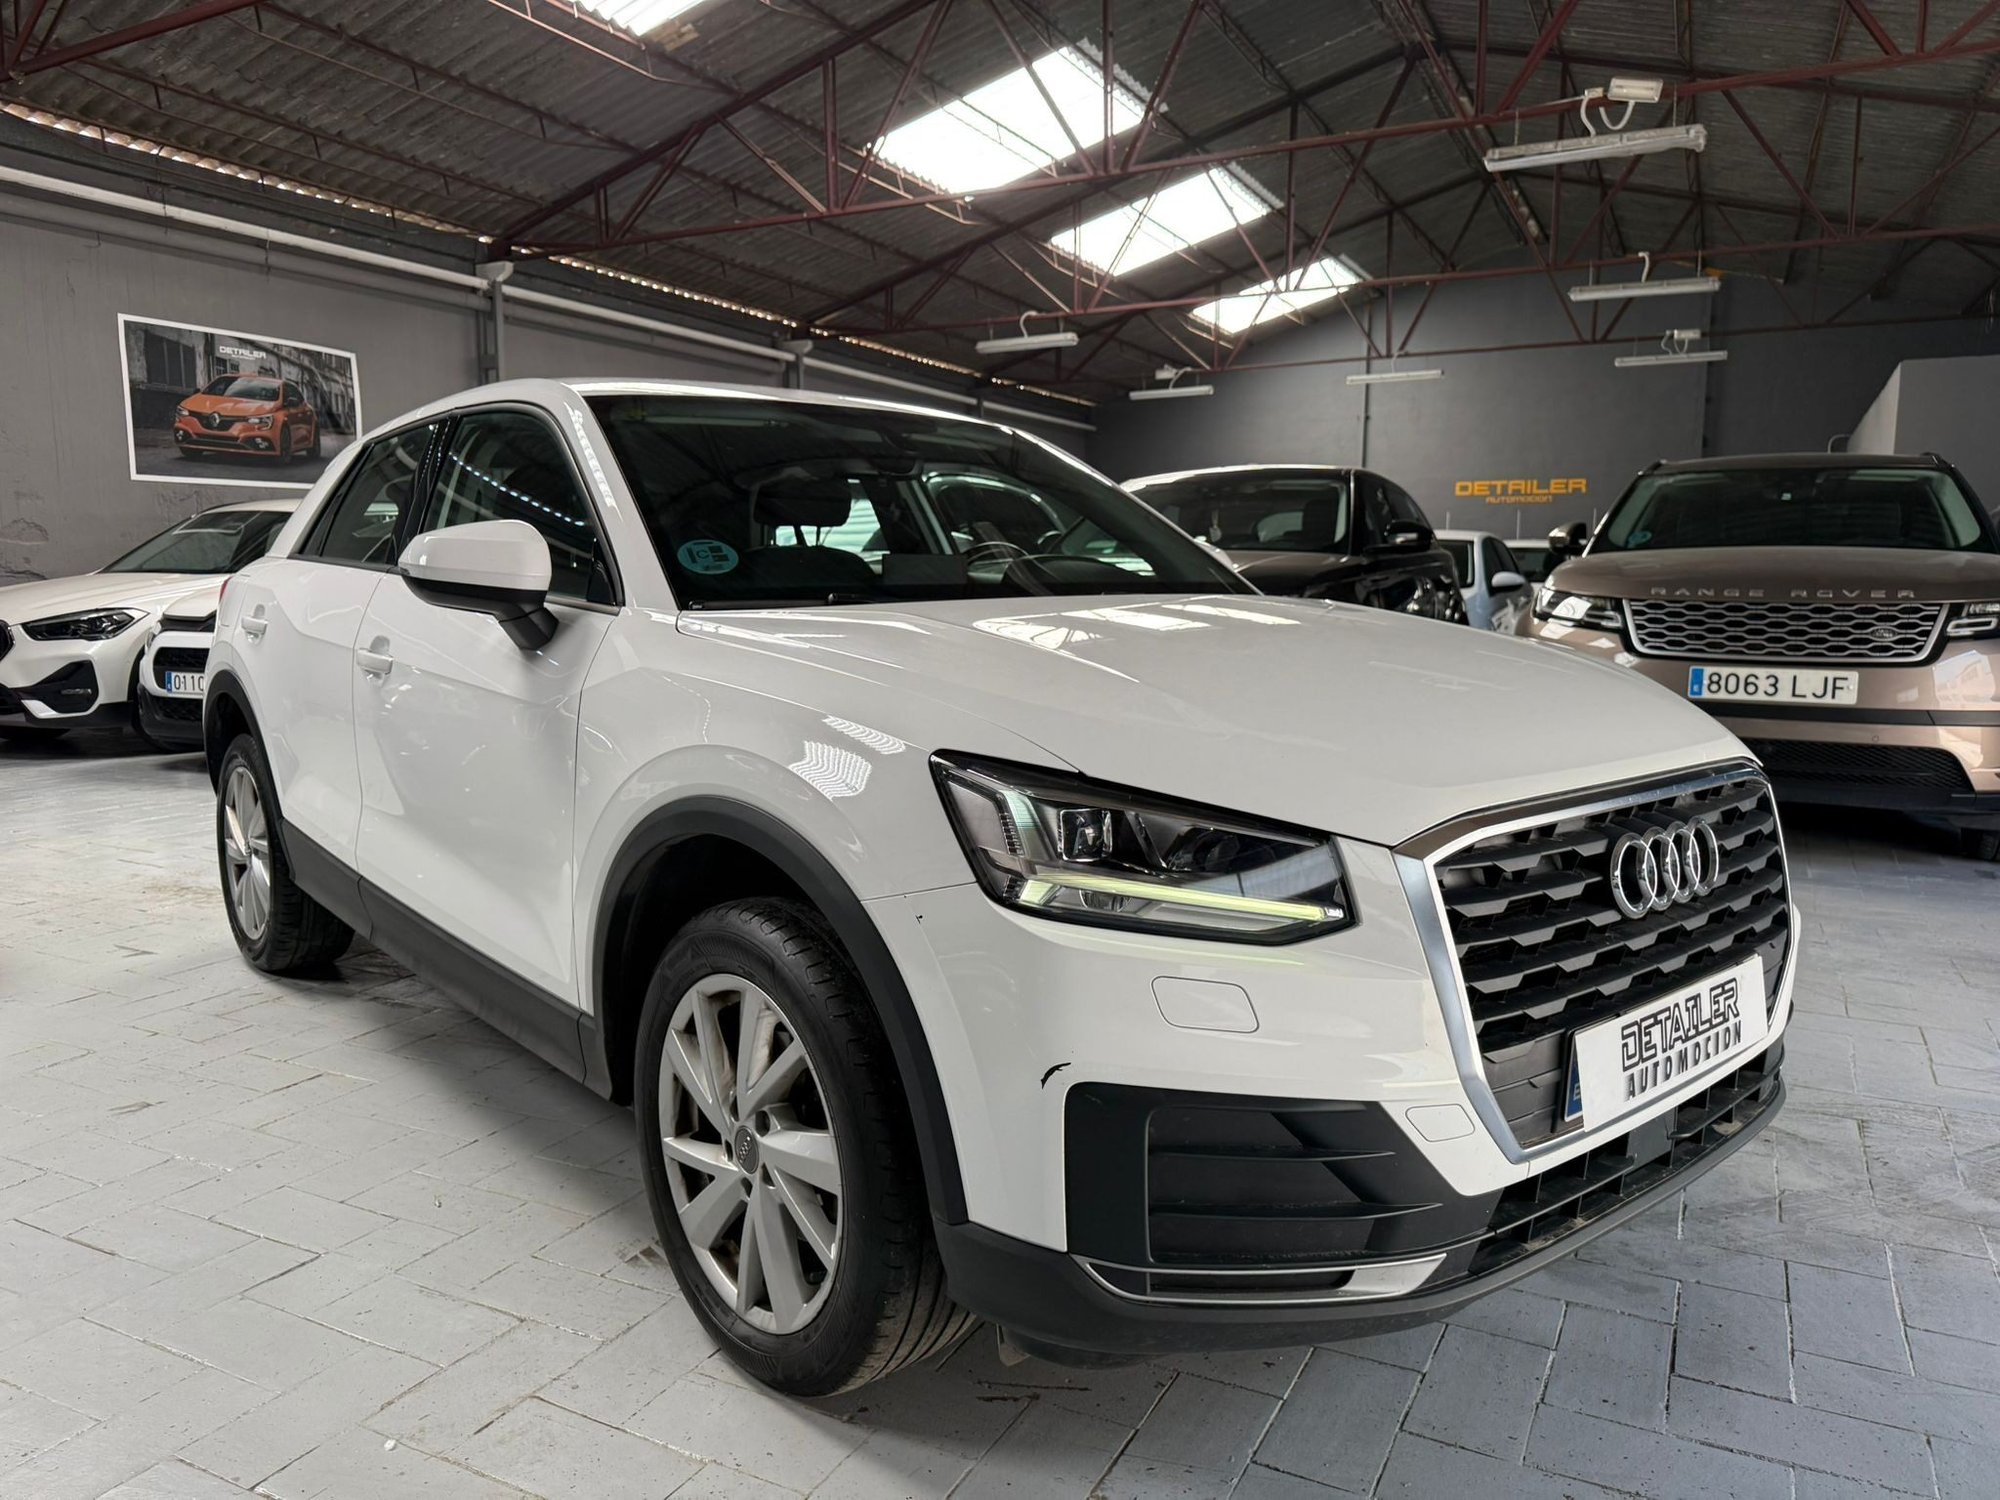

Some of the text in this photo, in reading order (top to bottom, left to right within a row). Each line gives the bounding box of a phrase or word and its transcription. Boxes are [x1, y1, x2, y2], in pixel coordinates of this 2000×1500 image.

[219, 346, 267, 359] DETAILER
[1455, 478, 1586, 495] DETAILER
[1651, 587, 1915, 599] RANGE ROVER
[1707, 672, 1848, 699] 8063 LJF
[1621, 977, 1740, 1072] DETAILER
[1624, 1020, 1741, 1102] AUTOMOCION
